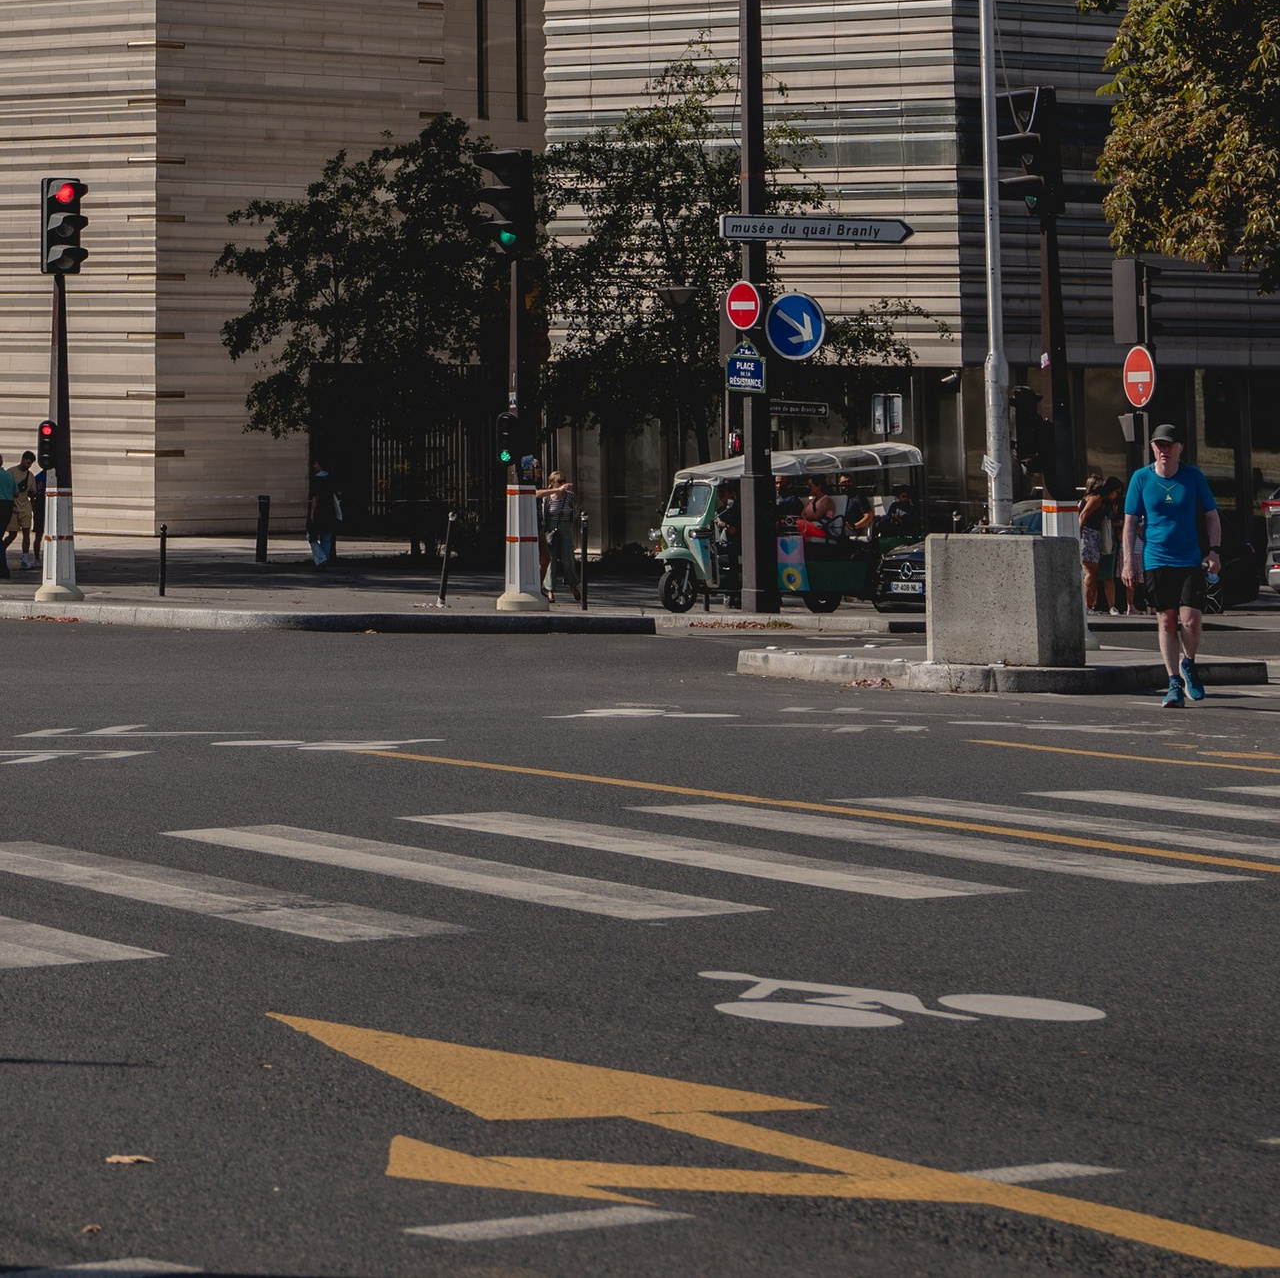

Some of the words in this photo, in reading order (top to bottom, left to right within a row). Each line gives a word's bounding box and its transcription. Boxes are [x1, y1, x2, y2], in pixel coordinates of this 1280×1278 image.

[731, 222, 774, 234] musée
[781, 223, 796, 235] du
[802, 224, 831, 237] quai
[837, 224, 881, 239] Branly
[736, 361, 755, 371] PLACE
[729, 376, 762, 387] RÉSISTANCE
